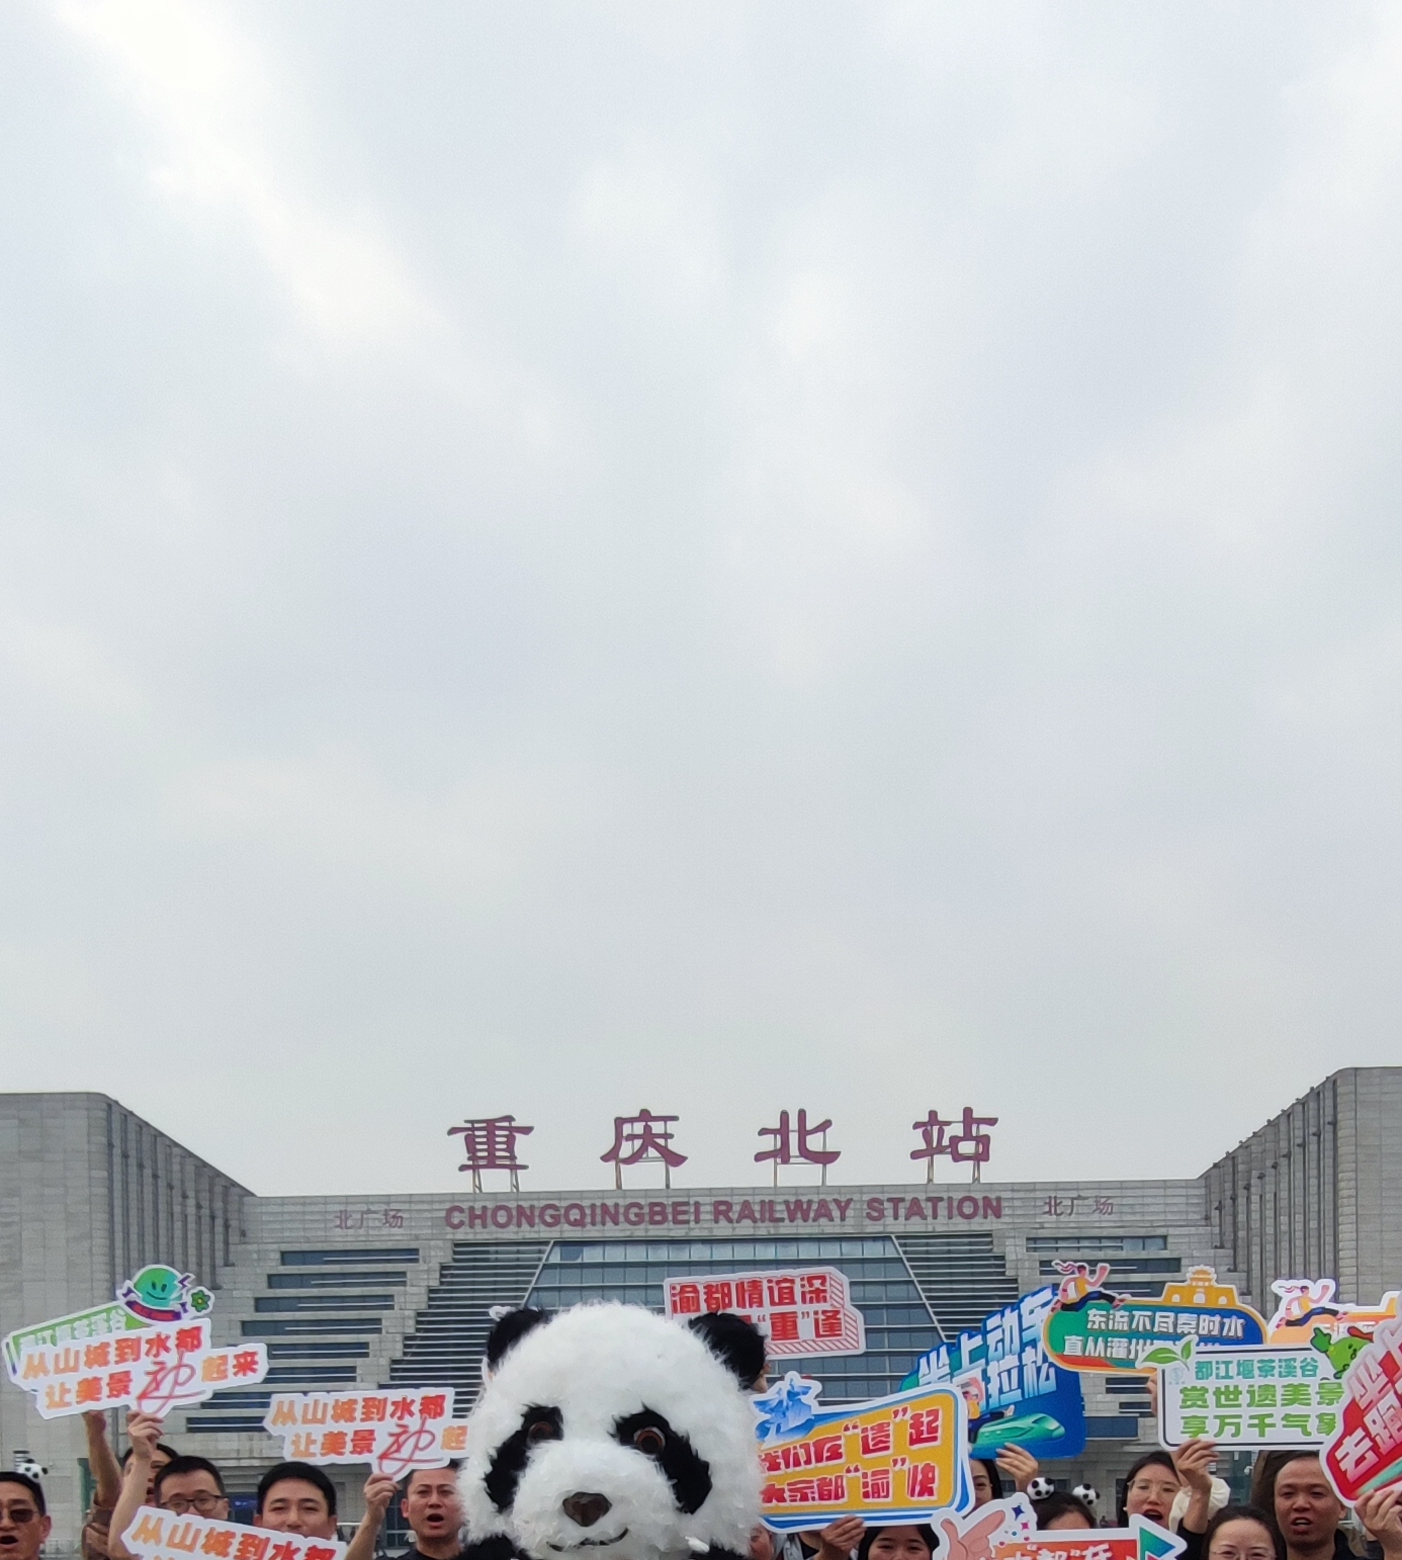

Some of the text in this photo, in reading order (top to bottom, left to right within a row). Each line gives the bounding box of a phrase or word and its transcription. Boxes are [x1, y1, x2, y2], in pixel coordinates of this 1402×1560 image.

[446, 1106, 999, 1172] 重庆北站
[334, 1208, 404, 1230] 北广场
[445, 1196, 1002, 1230] CHONGQINGBEI RAILWAY STATION
[1043, 1194, 1113, 1217] 北广场
[671, 1275, 829, 1313] 渝都情谊深
[739, 1309, 844, 1341] “重”逢
[919, 1287, 1057, 1387] 坐上动车
[1087, 1308, 1244, 1339] 东流不尽秦时水
[22, 1326, 202, 1379] 从山城到水都
[1195, 1357, 1319, 1381] 都江堰茶溪谷
[1179, 1382, 1344, 1409] 赏世遗美景
[272, 1396, 446, 1427] 从山城到水都
[1180, 1412, 1337, 1438] 享万千气象
[291, 1418, 467, 1474] 让美景动起
